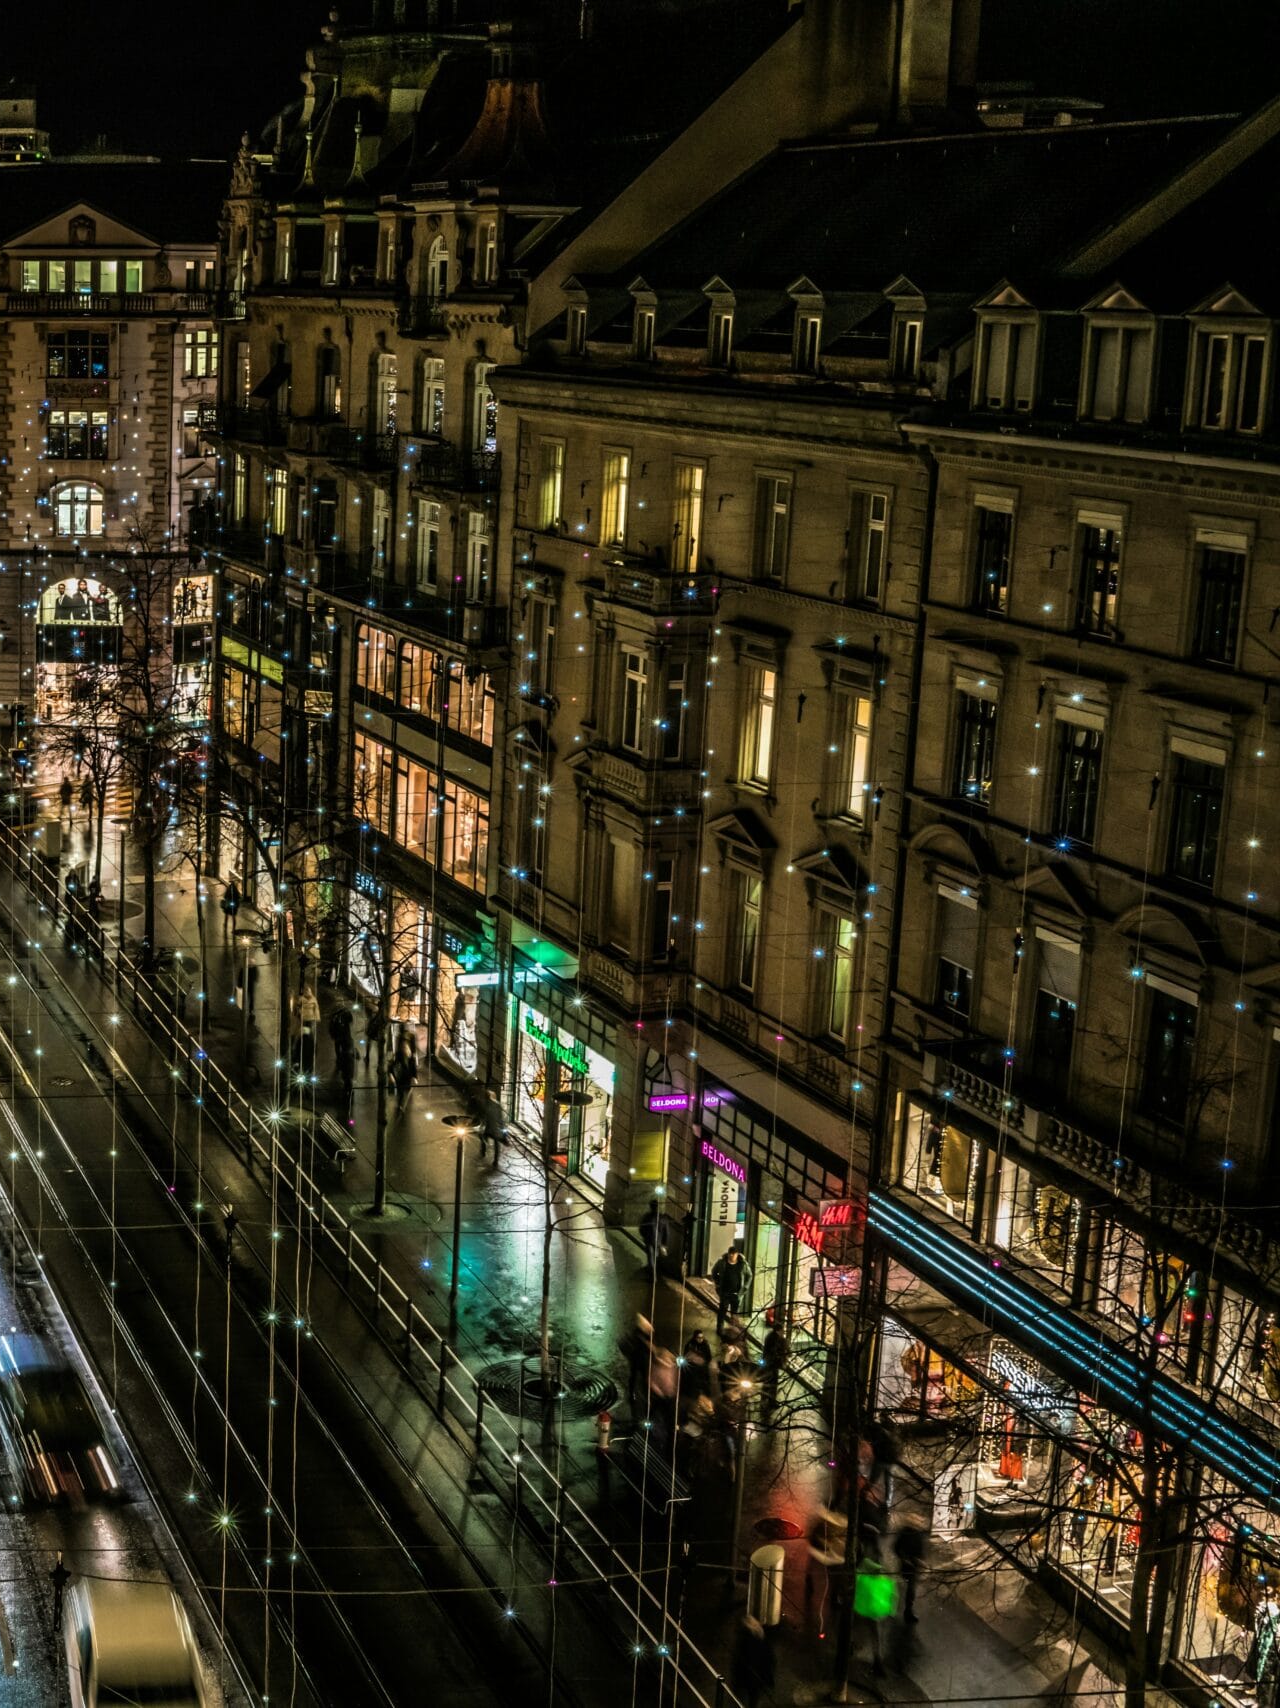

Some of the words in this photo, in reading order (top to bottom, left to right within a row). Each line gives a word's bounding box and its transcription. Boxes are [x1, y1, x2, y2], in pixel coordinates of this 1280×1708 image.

[355, 872, 382, 899] ESPRT
[651, 1099, 687, 1107] BELDONA
[703, 1141, 744, 1183] BELDONA
[720, 1180, 729, 1226] BELDONA
